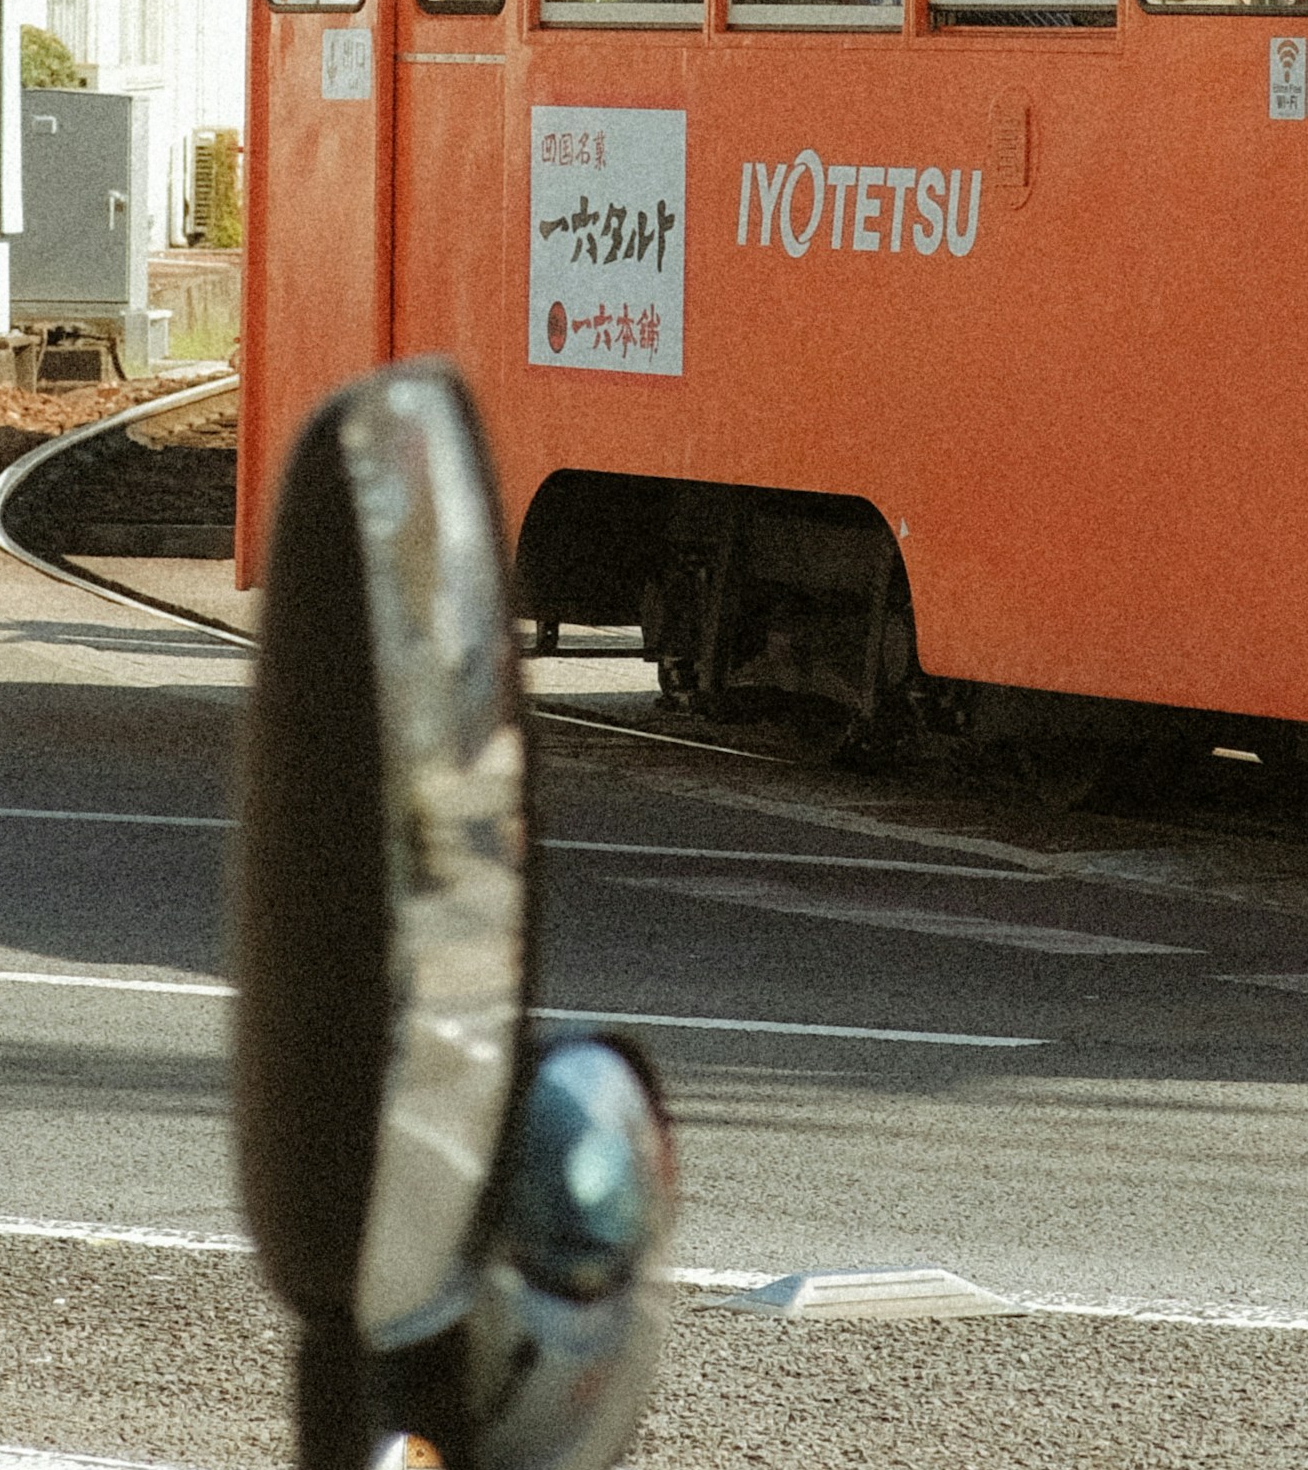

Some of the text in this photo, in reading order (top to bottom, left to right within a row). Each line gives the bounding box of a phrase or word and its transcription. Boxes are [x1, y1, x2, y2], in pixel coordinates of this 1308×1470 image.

[540, 131, 608, 171] 四国名菓
[537, 194, 676, 273] 一六タルト
[736, 148, 983, 258] IYOTETSU
[570, 301, 662, 364] 一六本舗
